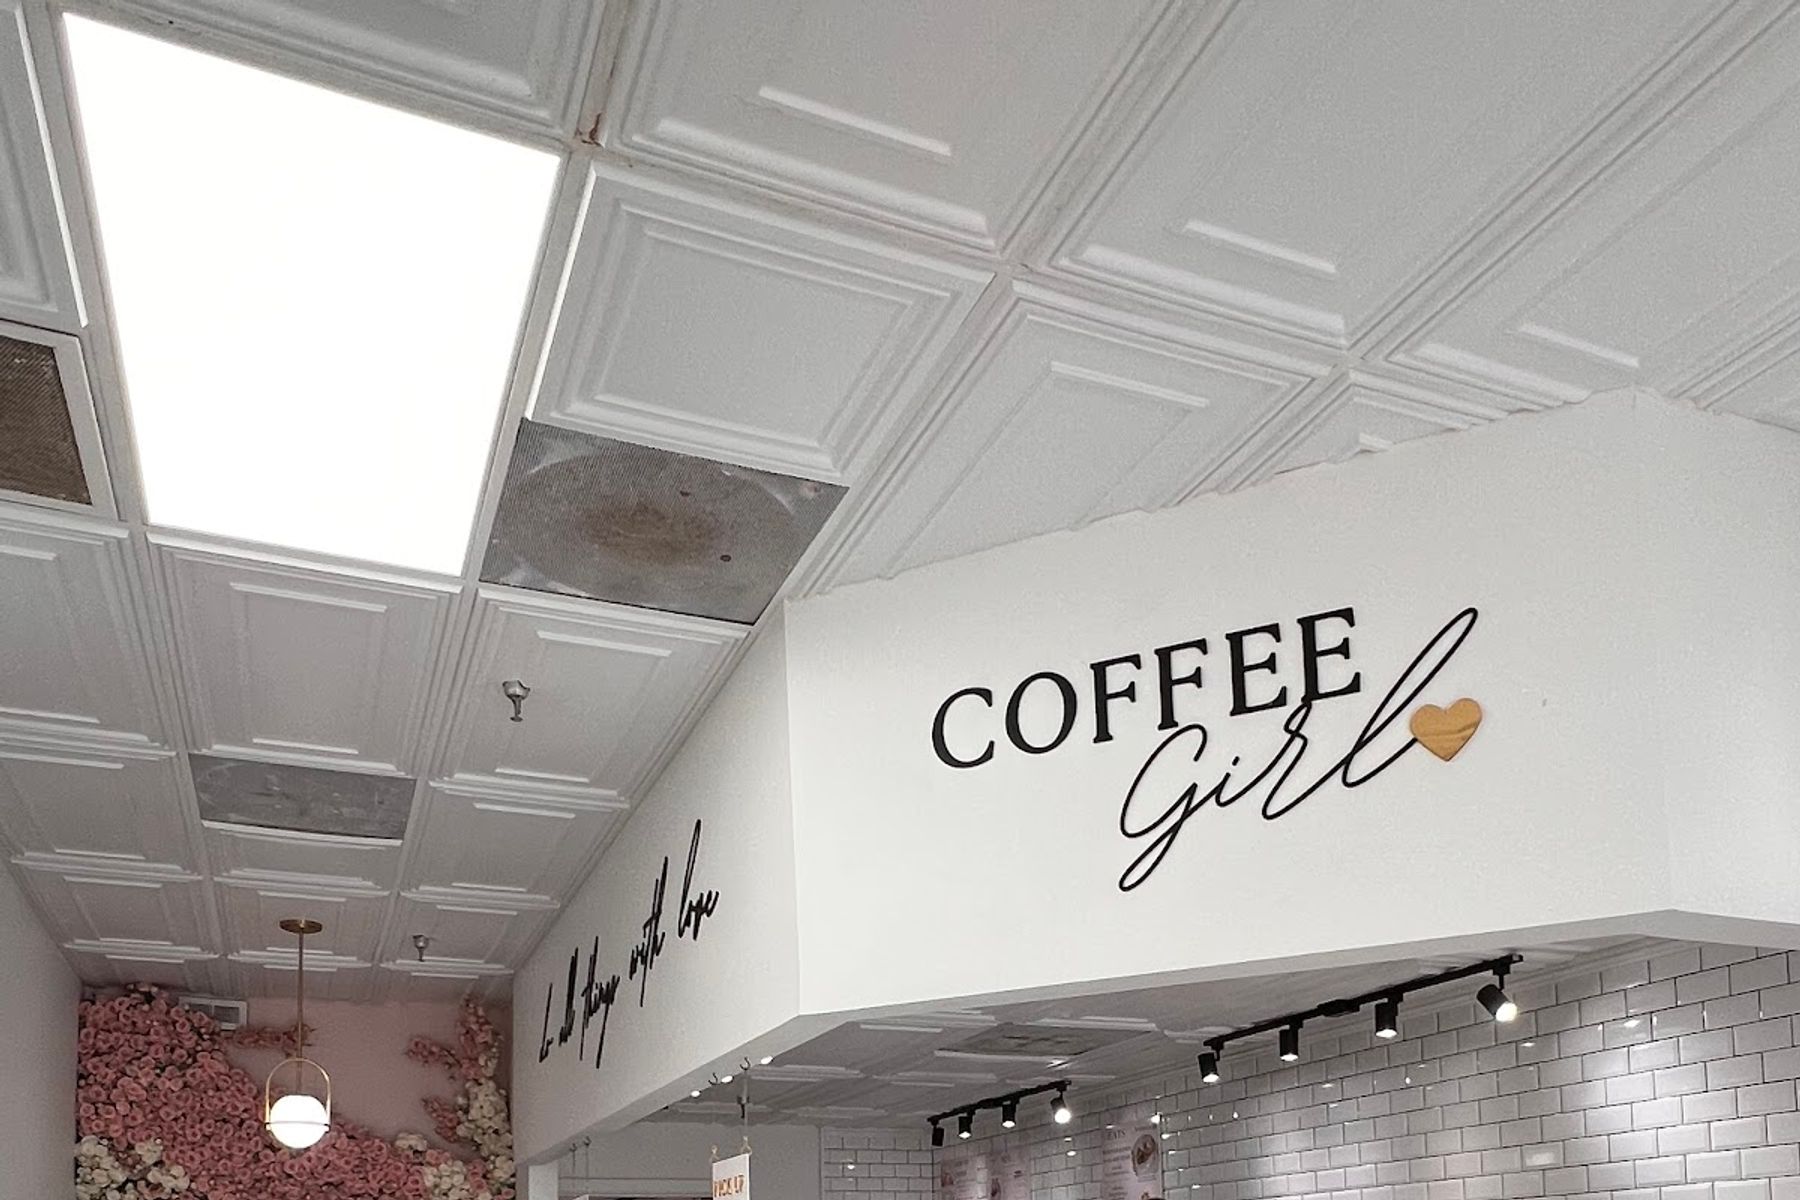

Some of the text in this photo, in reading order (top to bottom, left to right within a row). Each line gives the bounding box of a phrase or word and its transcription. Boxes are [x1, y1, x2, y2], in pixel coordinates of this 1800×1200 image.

[931, 607, 1362, 769] COFFEE
[1118, 608, 1478, 892] Girl
[677, 818, 720, 941] love
